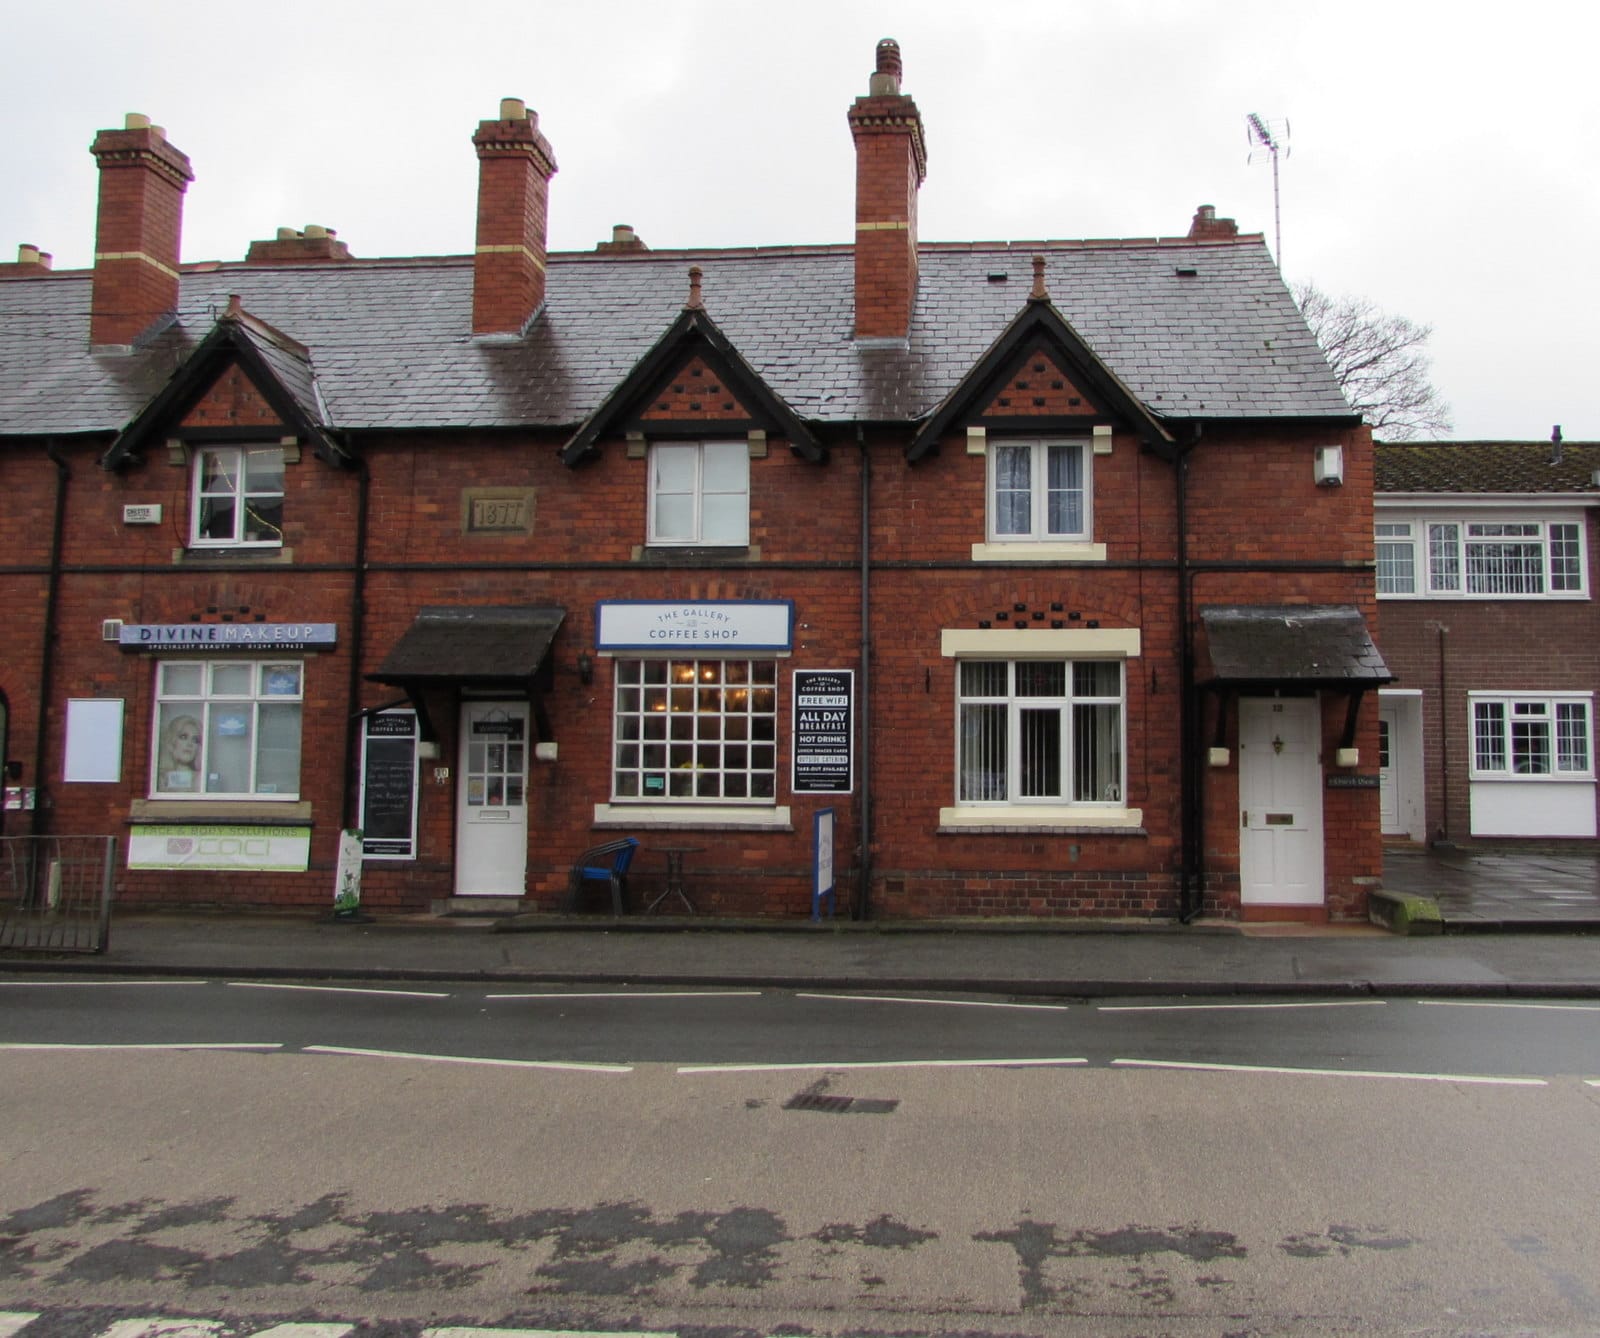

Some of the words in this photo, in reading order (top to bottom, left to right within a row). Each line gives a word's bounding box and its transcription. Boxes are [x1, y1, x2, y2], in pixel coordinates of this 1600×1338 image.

[476, 502, 524, 525] 1877
[657, 610, 679, 623] THE
[683, 608, 731, 623] GALLERY
[140, 627, 217, 641] DIVINE
[225, 626, 313, 640] MAKEUP
[649, 629, 698, 639] COFFEE
[703, 629, 739, 639] SHOP
[800, 696, 824, 705] FREE
[825, 696, 846, 705] WIFI
[799, 711, 820, 722] ALL
[823, 711, 847, 722] DAY
[799, 722, 846, 731] BREAKFAST
[799, 735, 816, 743] HOT
[817, 735, 847, 743] DRINKS
[142, 826, 171, 836] FACE
[190, 827, 223, 837] BODY
[229, 827, 297, 837] SOLUTIONS
